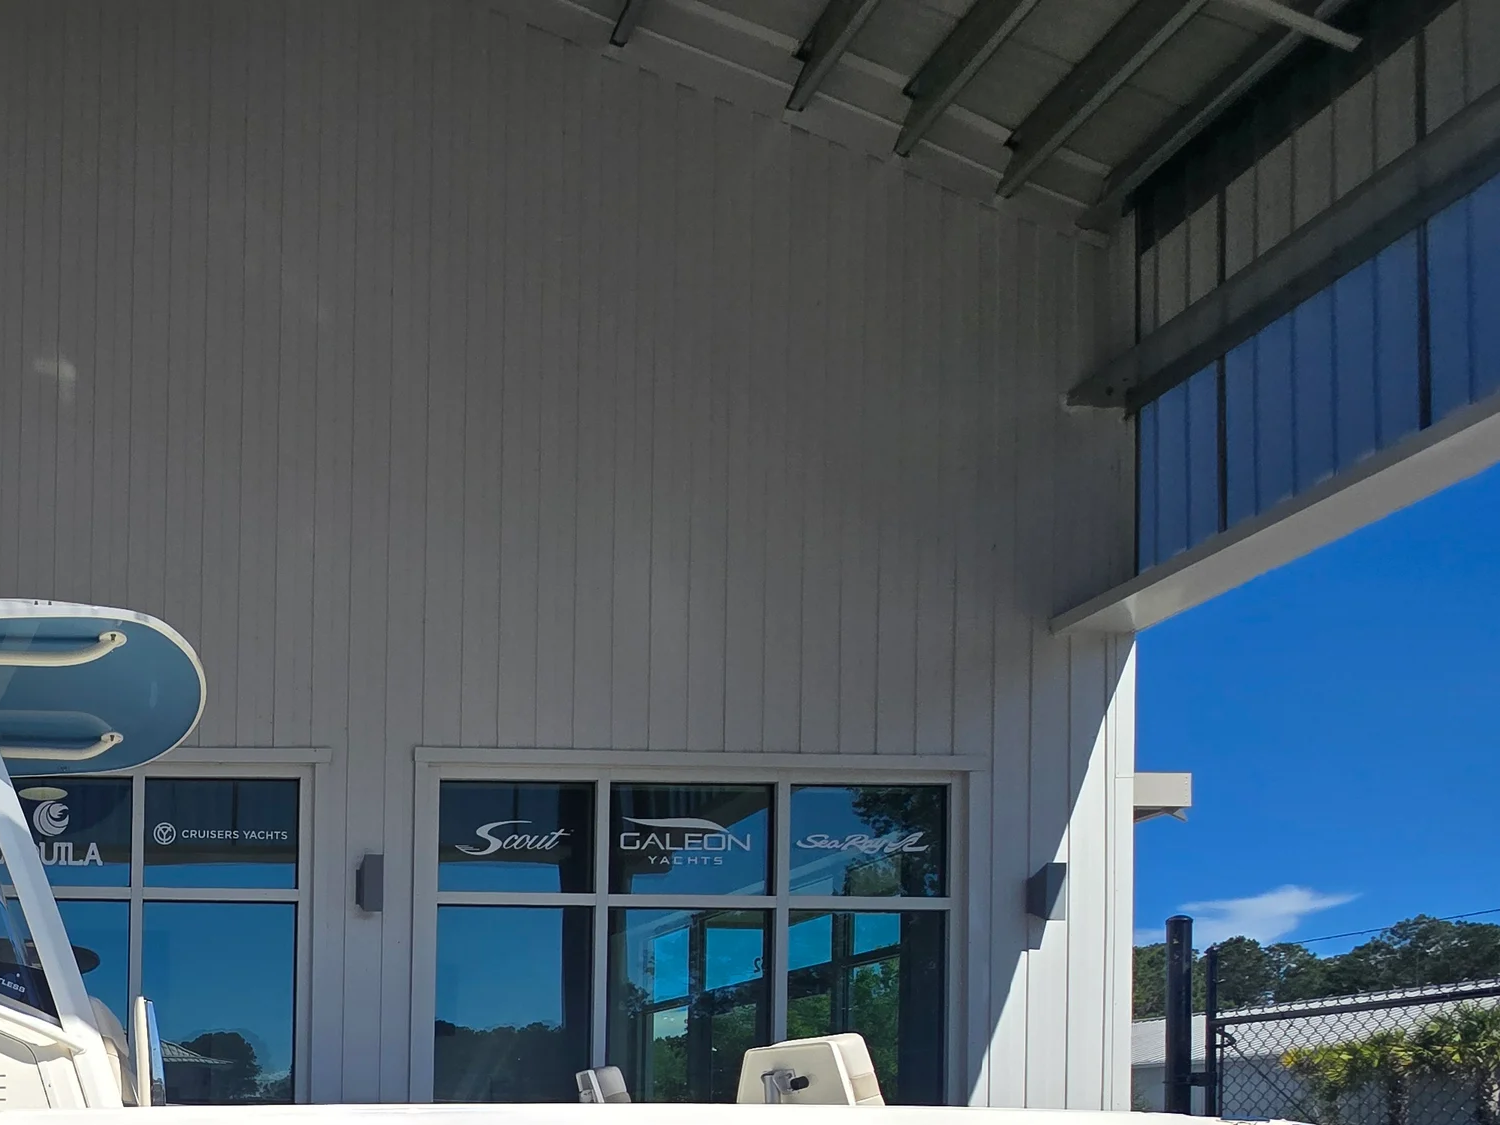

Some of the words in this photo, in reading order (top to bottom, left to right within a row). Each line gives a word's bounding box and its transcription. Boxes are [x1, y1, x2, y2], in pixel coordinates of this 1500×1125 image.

[181, 829, 240, 839] CRUISERS
[242, 830, 288, 840] YACHTS
[455, 820, 571, 855] Scout
[620, 832, 751, 851] GALEON
[796, 834, 843, 849] Sea
[840, 834, 886, 854] Ray
[0, 842, 103, 866] UILA
[648, 856, 723, 865] YACHTS
